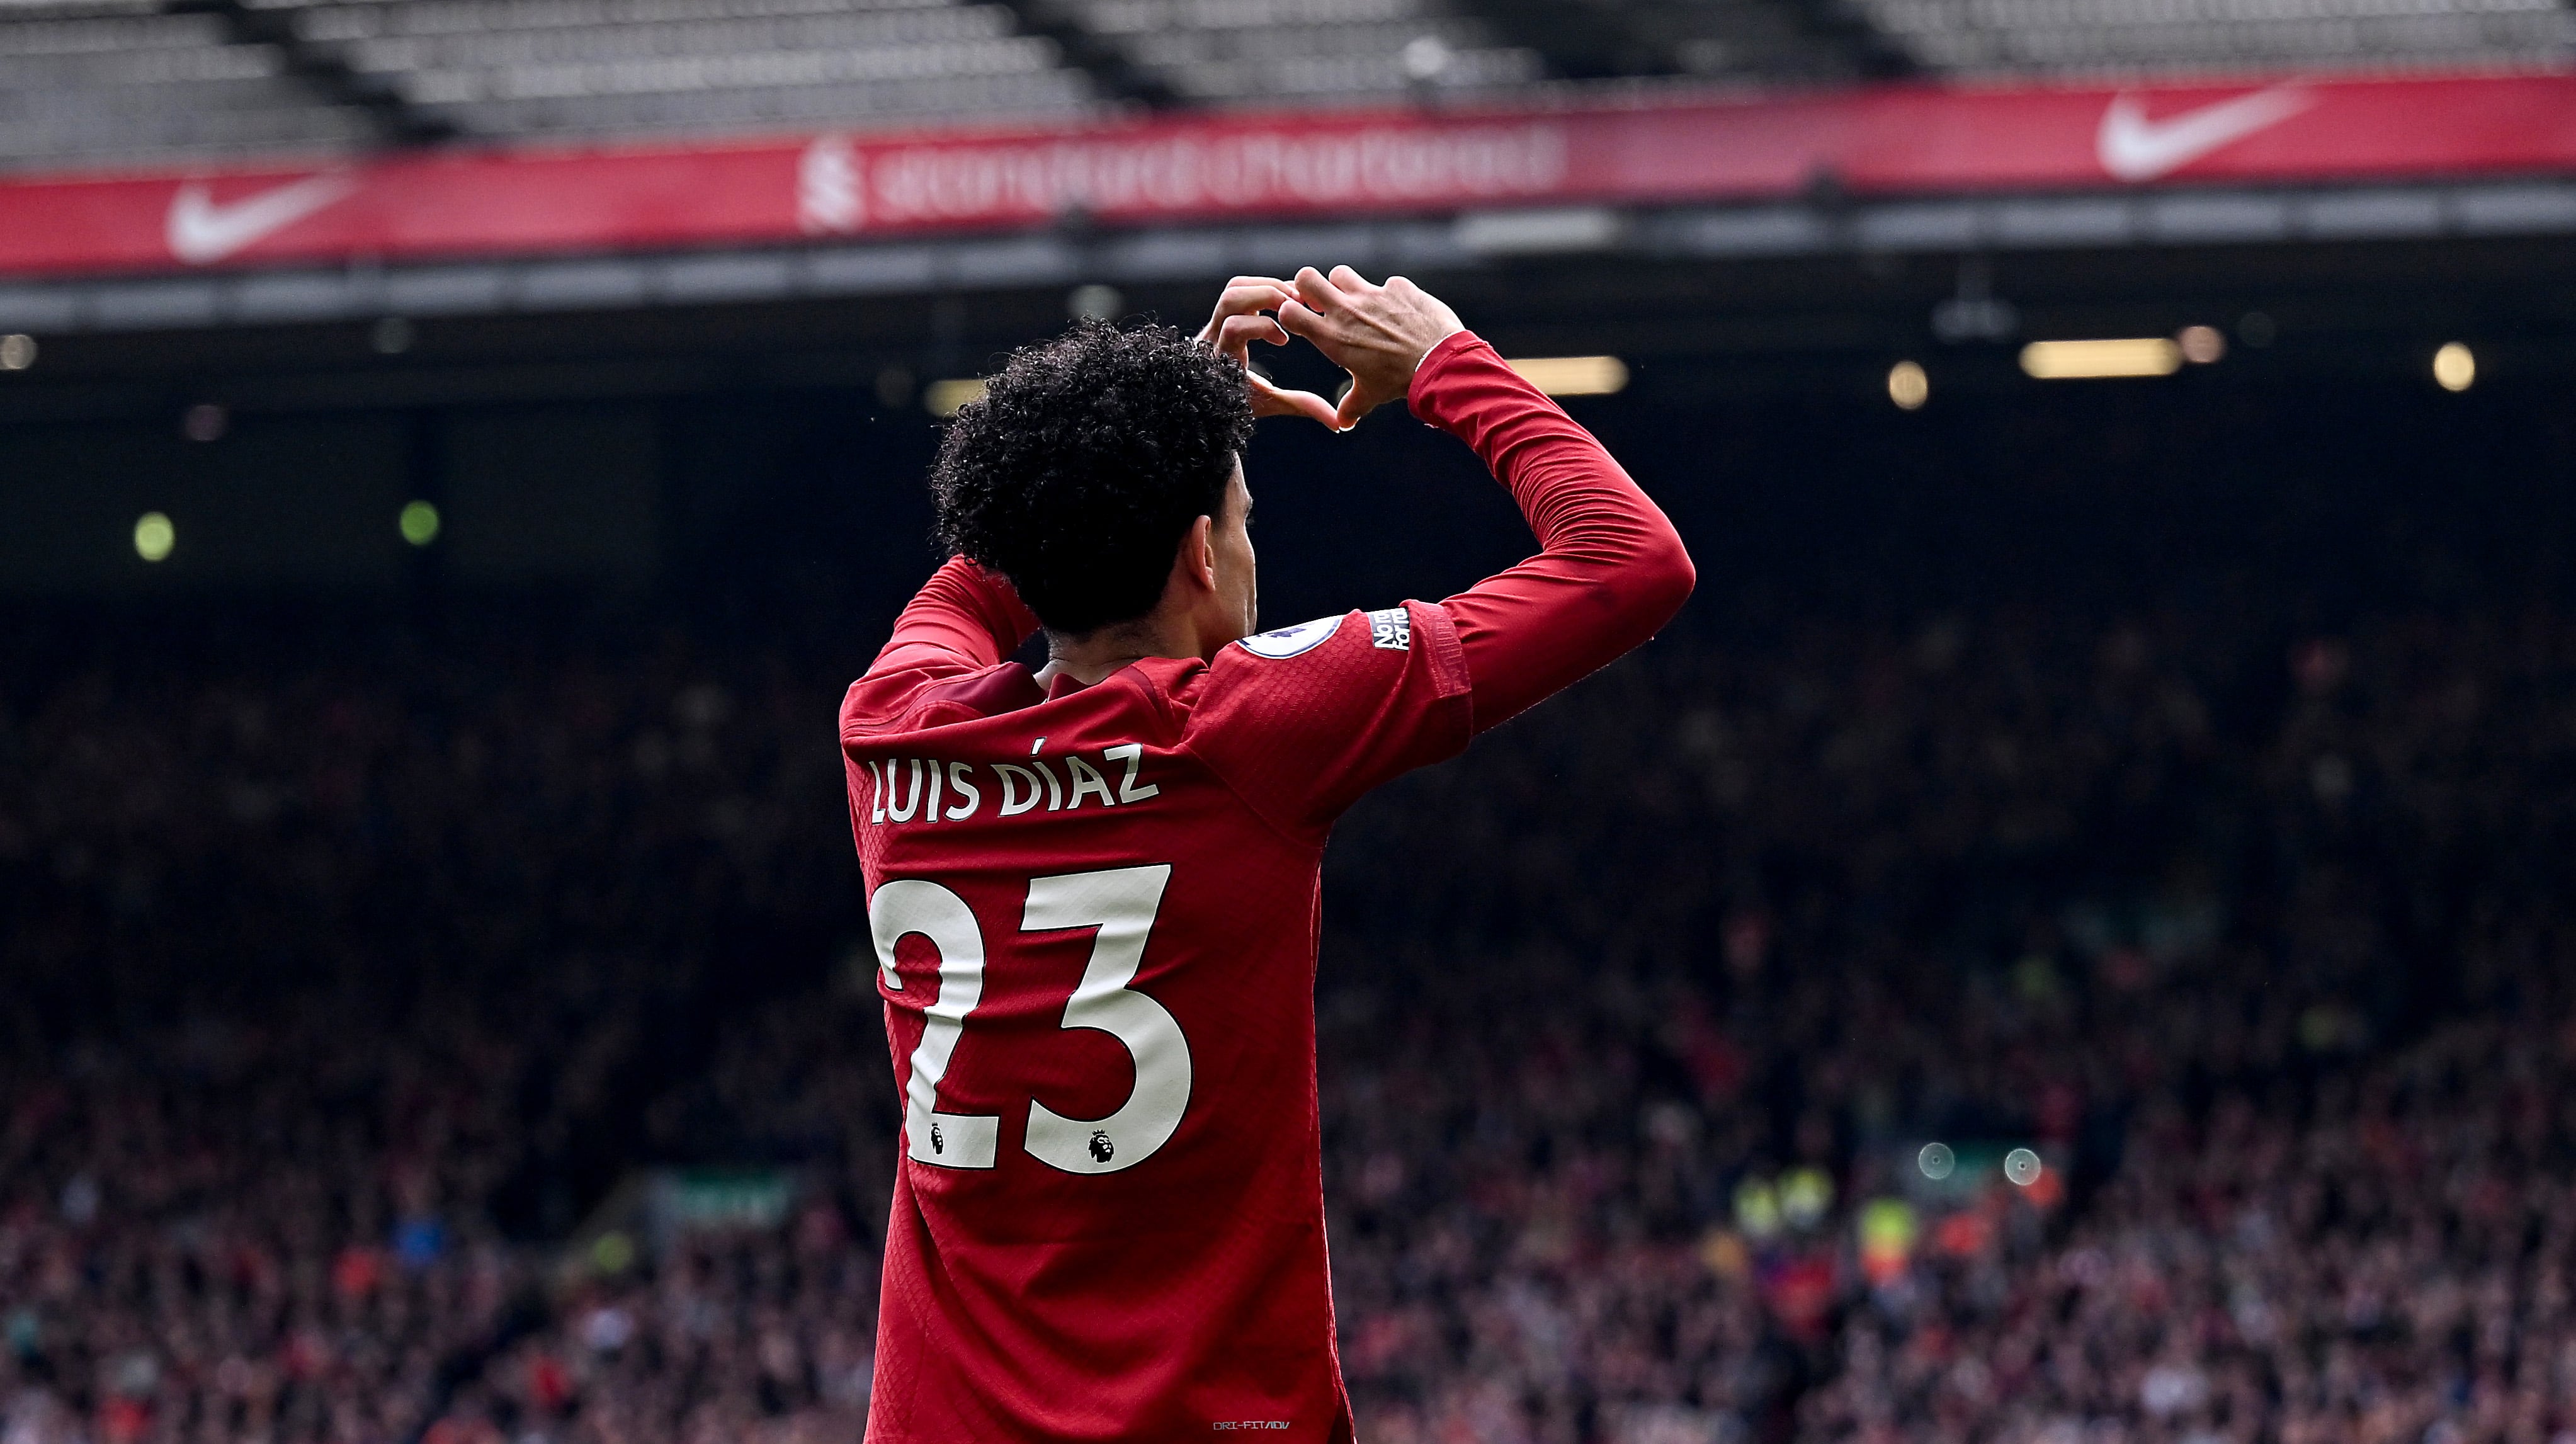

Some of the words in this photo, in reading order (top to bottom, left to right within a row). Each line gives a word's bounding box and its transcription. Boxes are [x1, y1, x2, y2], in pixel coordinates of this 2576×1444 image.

[868, 758, 981, 825] LUIS
[990, 736, 1159, 818] DÍAZ
[869, 862, 1194, 1176] 23
